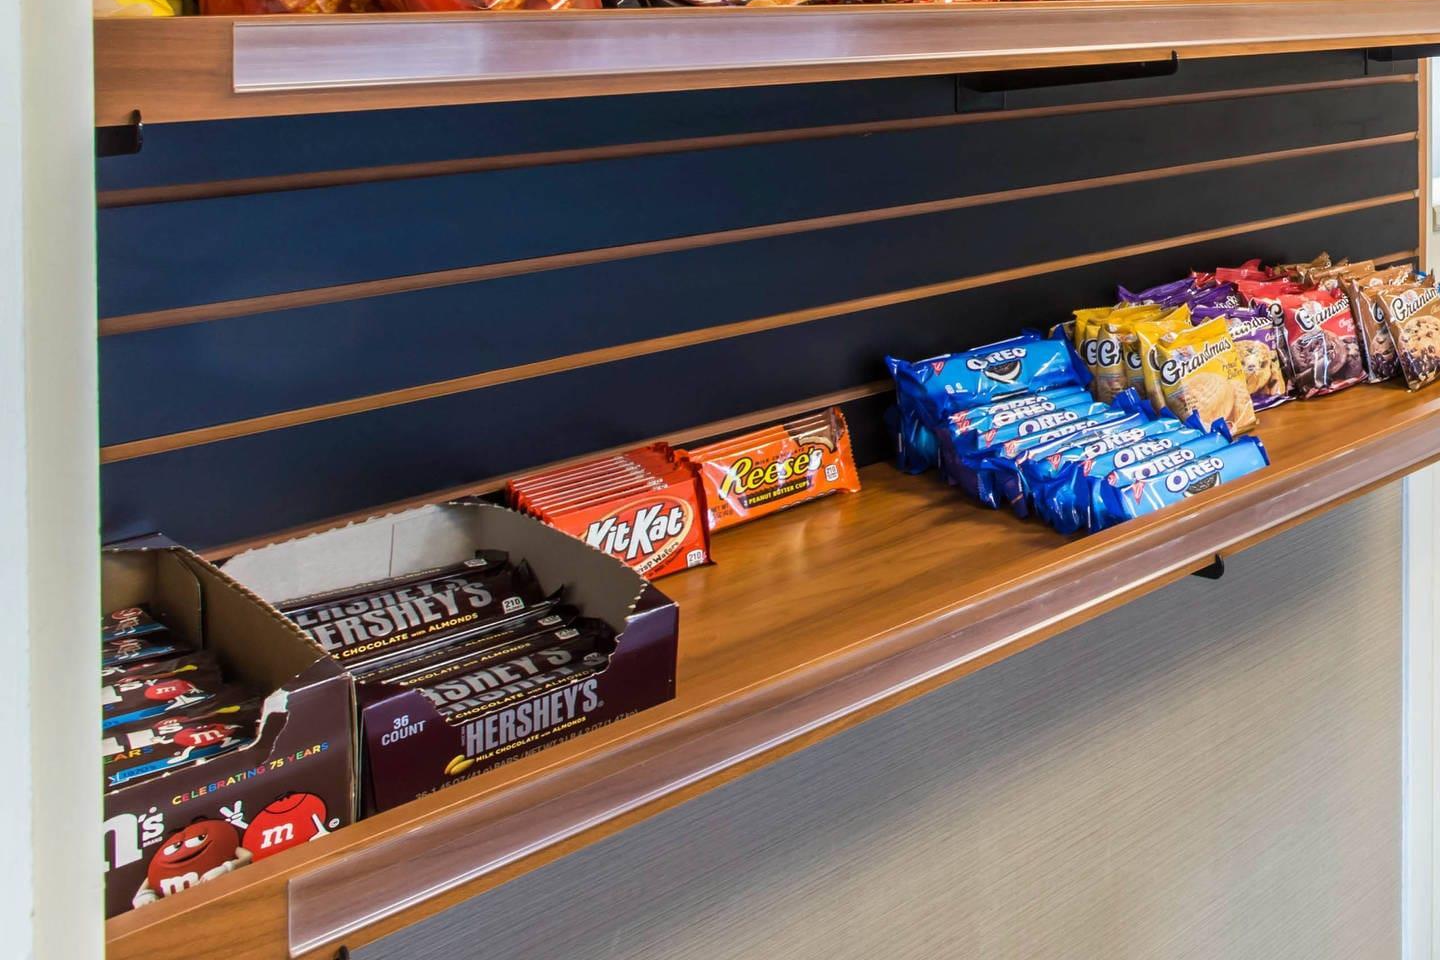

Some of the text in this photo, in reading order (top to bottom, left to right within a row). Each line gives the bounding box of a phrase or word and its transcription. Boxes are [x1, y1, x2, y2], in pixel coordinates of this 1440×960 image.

[966, 347, 1026, 371] OREO
[1018, 411, 1079, 437] OREO
[1113, 439, 1172, 469] OREO
[719, 447, 823, 499] Reese's
[1165, 457, 1224, 493] OREO
[748, 492, 772, 504] PEANUT
[773, 484, 795, 497] BUTTER
[342, 632, 408, 658] CHOCOLATE
[428, 612, 478, 633] ALMONDS
[382, 720, 426, 747] COUNT
[393, 714, 409, 730] 36
[466, 678, 598, 758] HERSHEY'S
[476, 752, 494, 763] MILK
[495, 734, 540, 755] CHOCOLATE
[552, 716, 587, 732] ALMONDS
[172, 766, 265, 805] CELEBRATING
[269, 758, 284, 770] 75
[287, 742, 329, 762] YEARS
